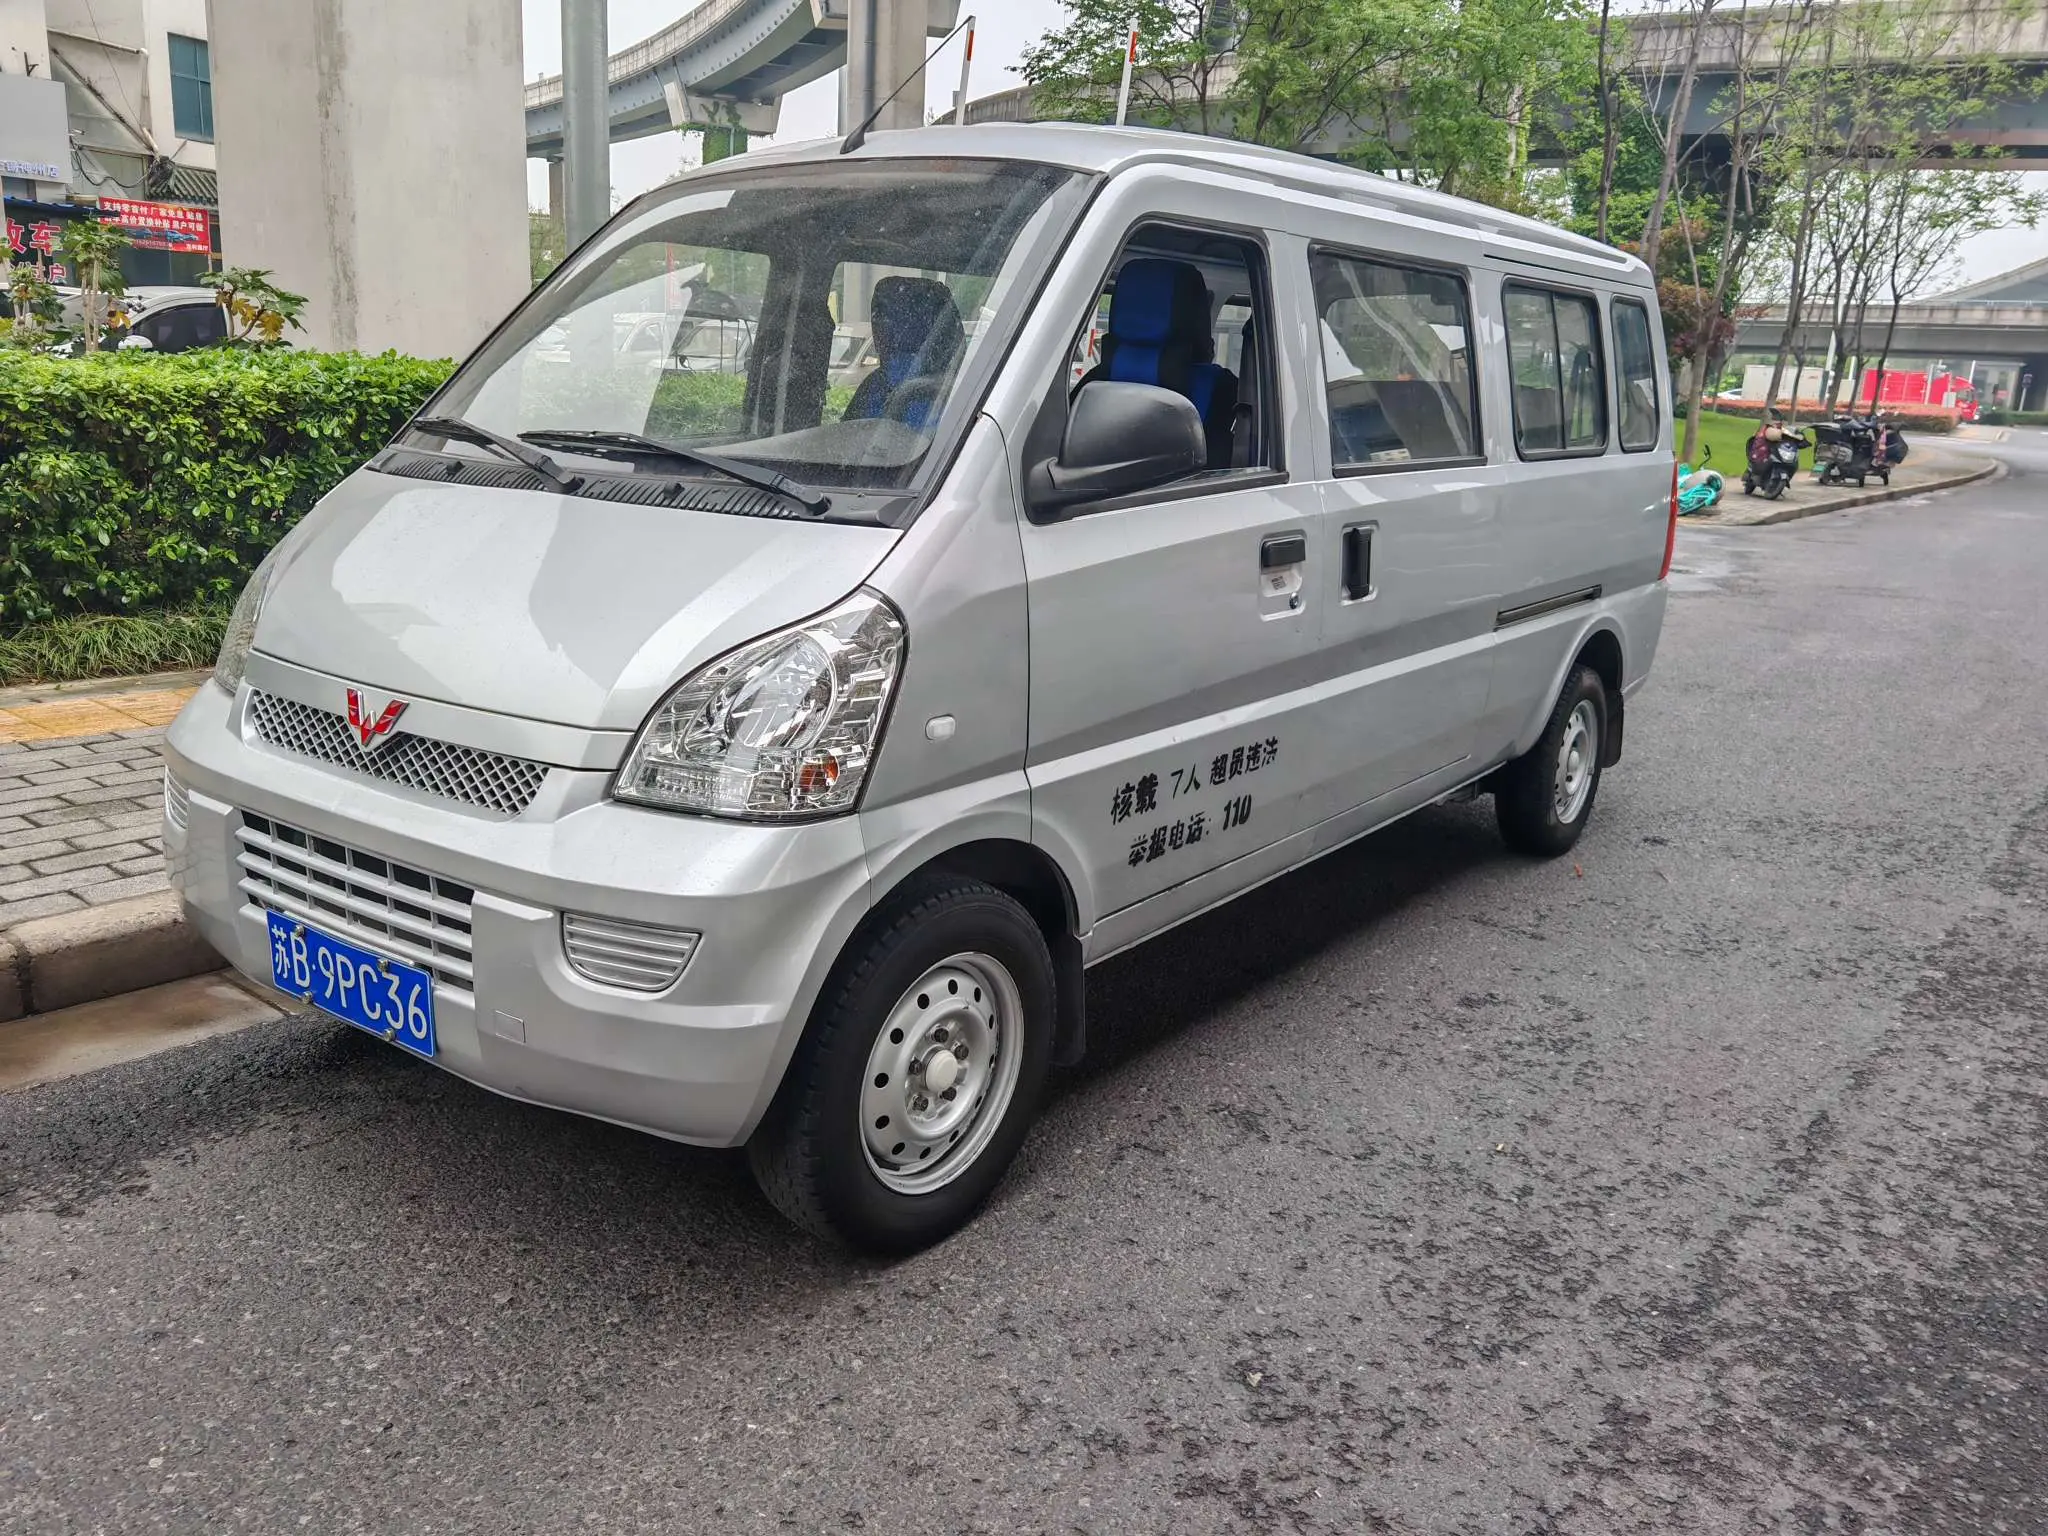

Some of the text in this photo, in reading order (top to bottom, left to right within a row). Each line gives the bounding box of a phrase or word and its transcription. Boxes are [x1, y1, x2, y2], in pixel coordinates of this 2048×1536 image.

[1110, 736, 1278, 825] 核载 7人 超员违法
[1222, 794, 1252, 831] 110
